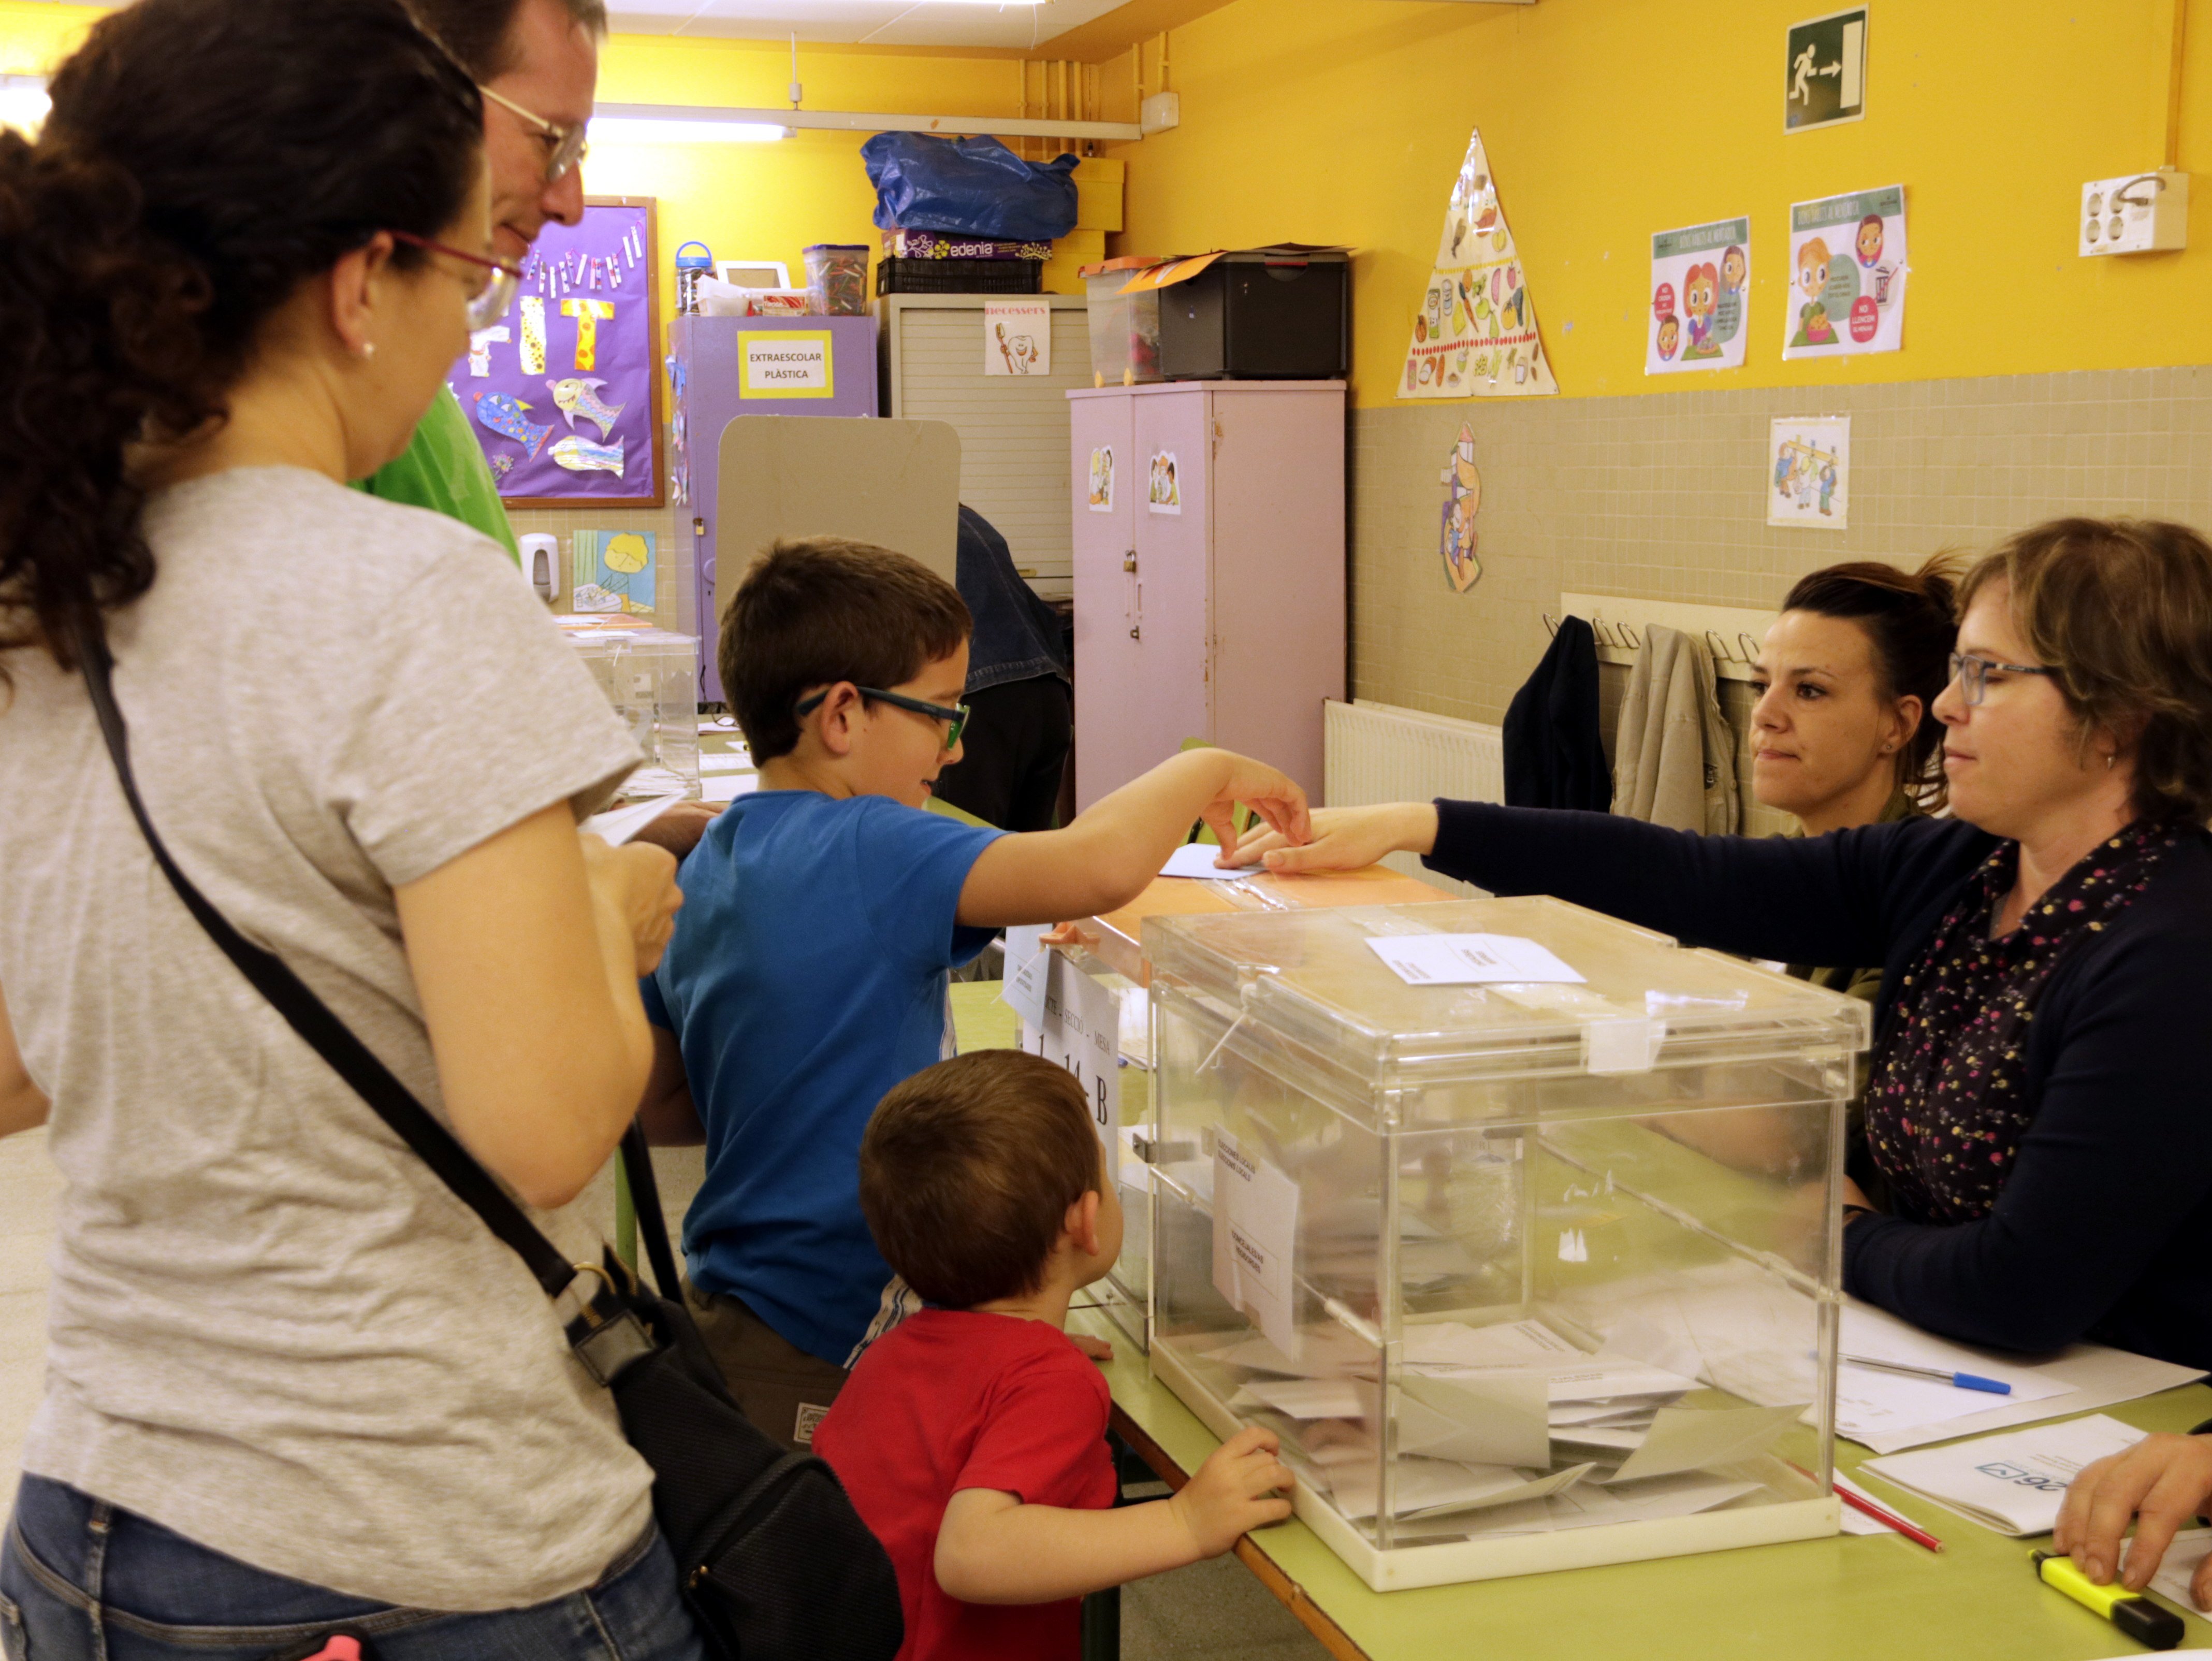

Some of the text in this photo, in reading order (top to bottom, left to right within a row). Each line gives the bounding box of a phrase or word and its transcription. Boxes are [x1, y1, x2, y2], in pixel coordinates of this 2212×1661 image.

[950, 241, 993, 257] edenia
[985, 307, 1045, 315] necessers
[1859, 305, 1869, 313] NO
[750, 353, 822, 362] EXTRAESCOLAR
[764, 368, 809, 379] PLÀSTICA
[1065, 1008, 1083, 1035] SECCIÓ
[1094, 1030, 1110, 1056] MESA
[1096, 1074, 1108, 1125] B
